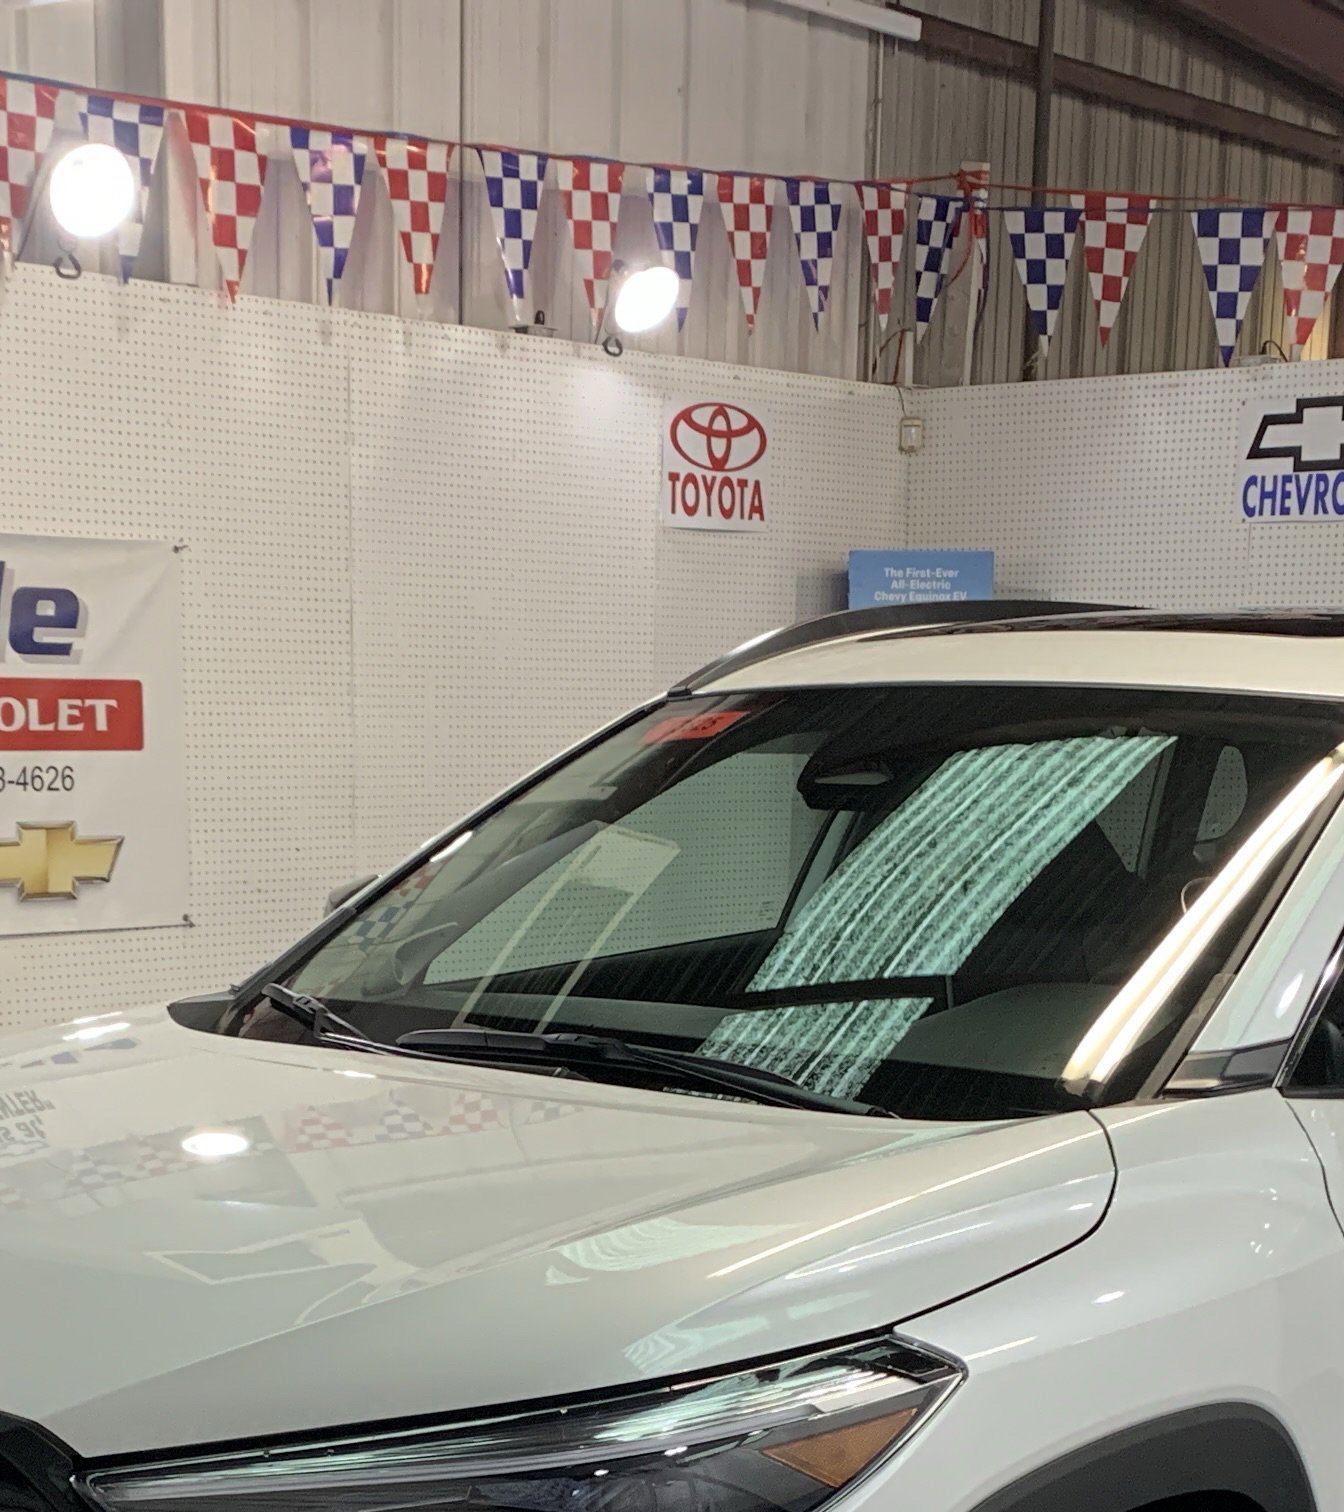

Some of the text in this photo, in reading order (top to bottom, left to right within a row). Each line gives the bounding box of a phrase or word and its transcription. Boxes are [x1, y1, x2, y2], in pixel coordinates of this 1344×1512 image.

[668, 471, 765, 522] TOYOTA
[884, 567, 960, 579] The First-Ever
[890, 579, 952, 590] All-Electric
[874, 591, 907, 603] Chevy
[953, 591, 968, 601] EV
